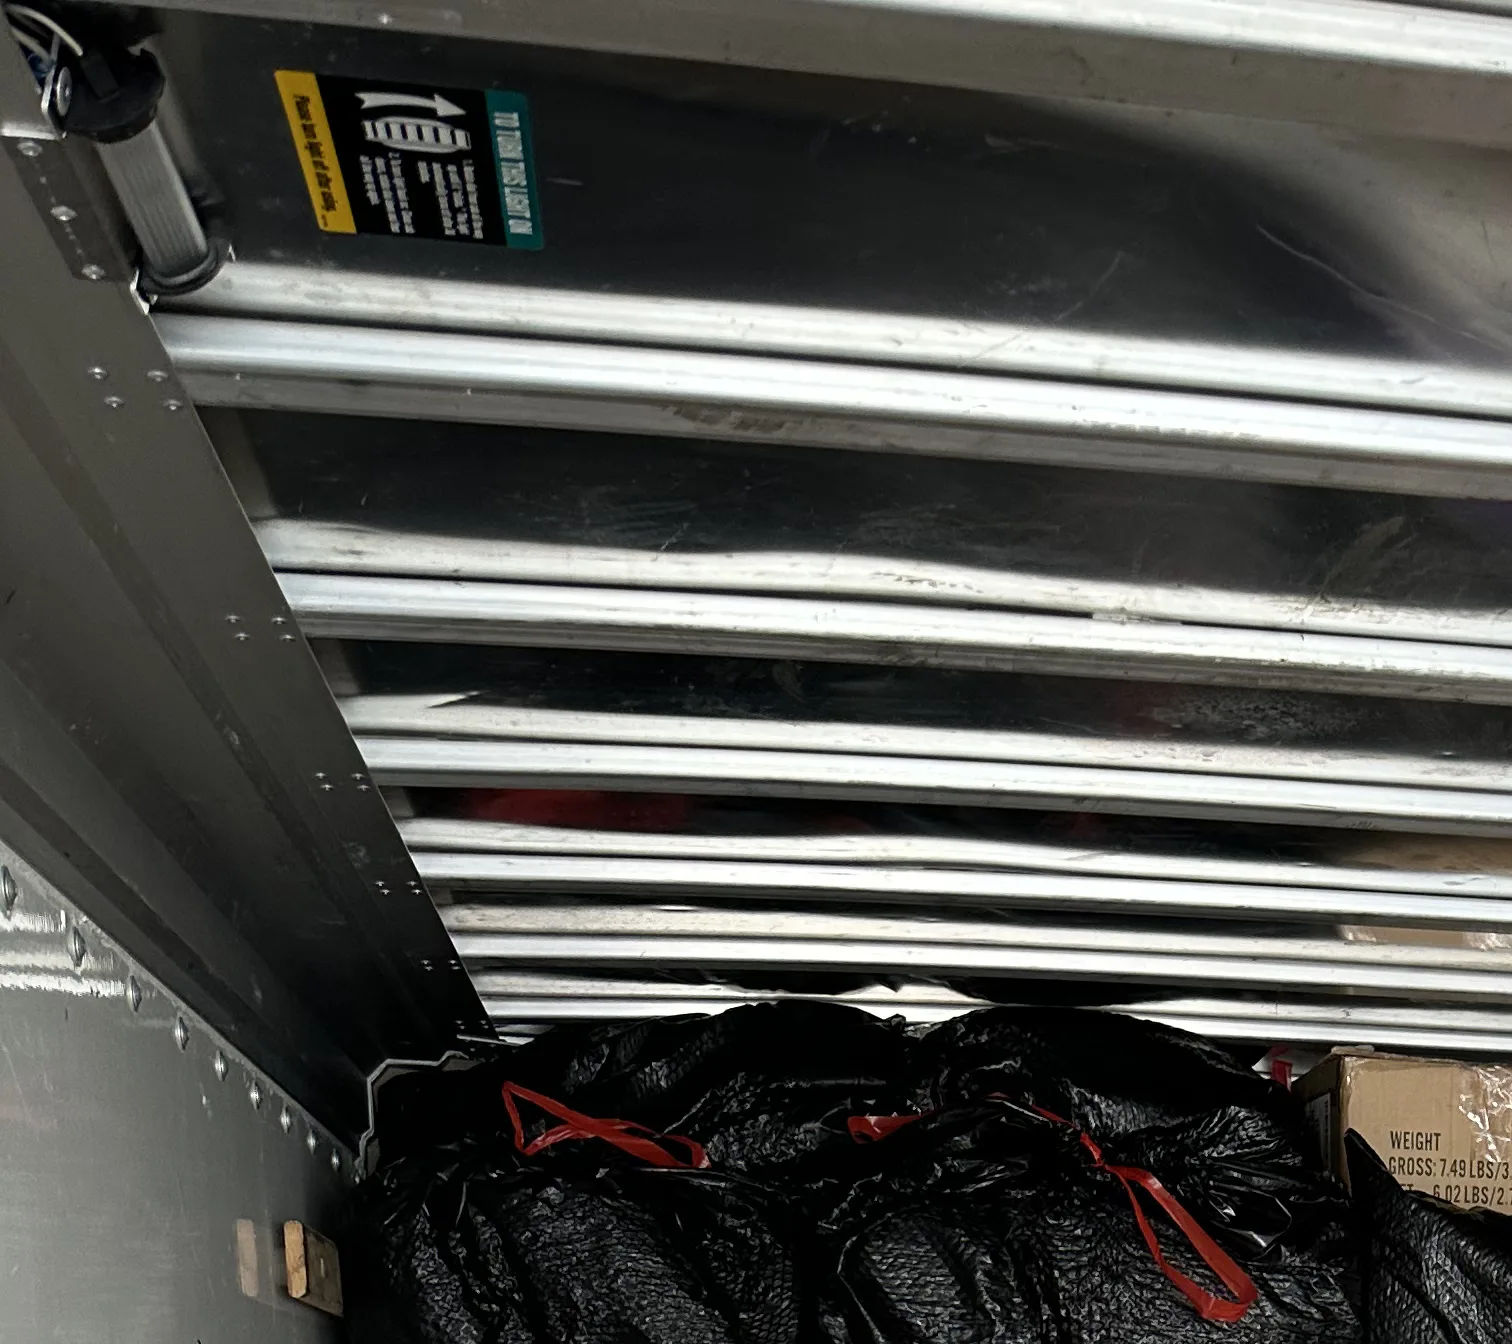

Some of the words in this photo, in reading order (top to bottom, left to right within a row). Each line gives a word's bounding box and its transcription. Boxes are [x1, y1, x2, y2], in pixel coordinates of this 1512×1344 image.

[493, 111, 520, 128] TO
[501, 161, 527, 187] THIS
[504, 187, 531, 219] LIGHT
[508, 219, 533, 235] ON
[1390, 1131, 1441, 1151] WEIGHT
[1388, 1156, 1437, 1177] GROSS:
[1440, 1159, 1466, 1178] 7.49
